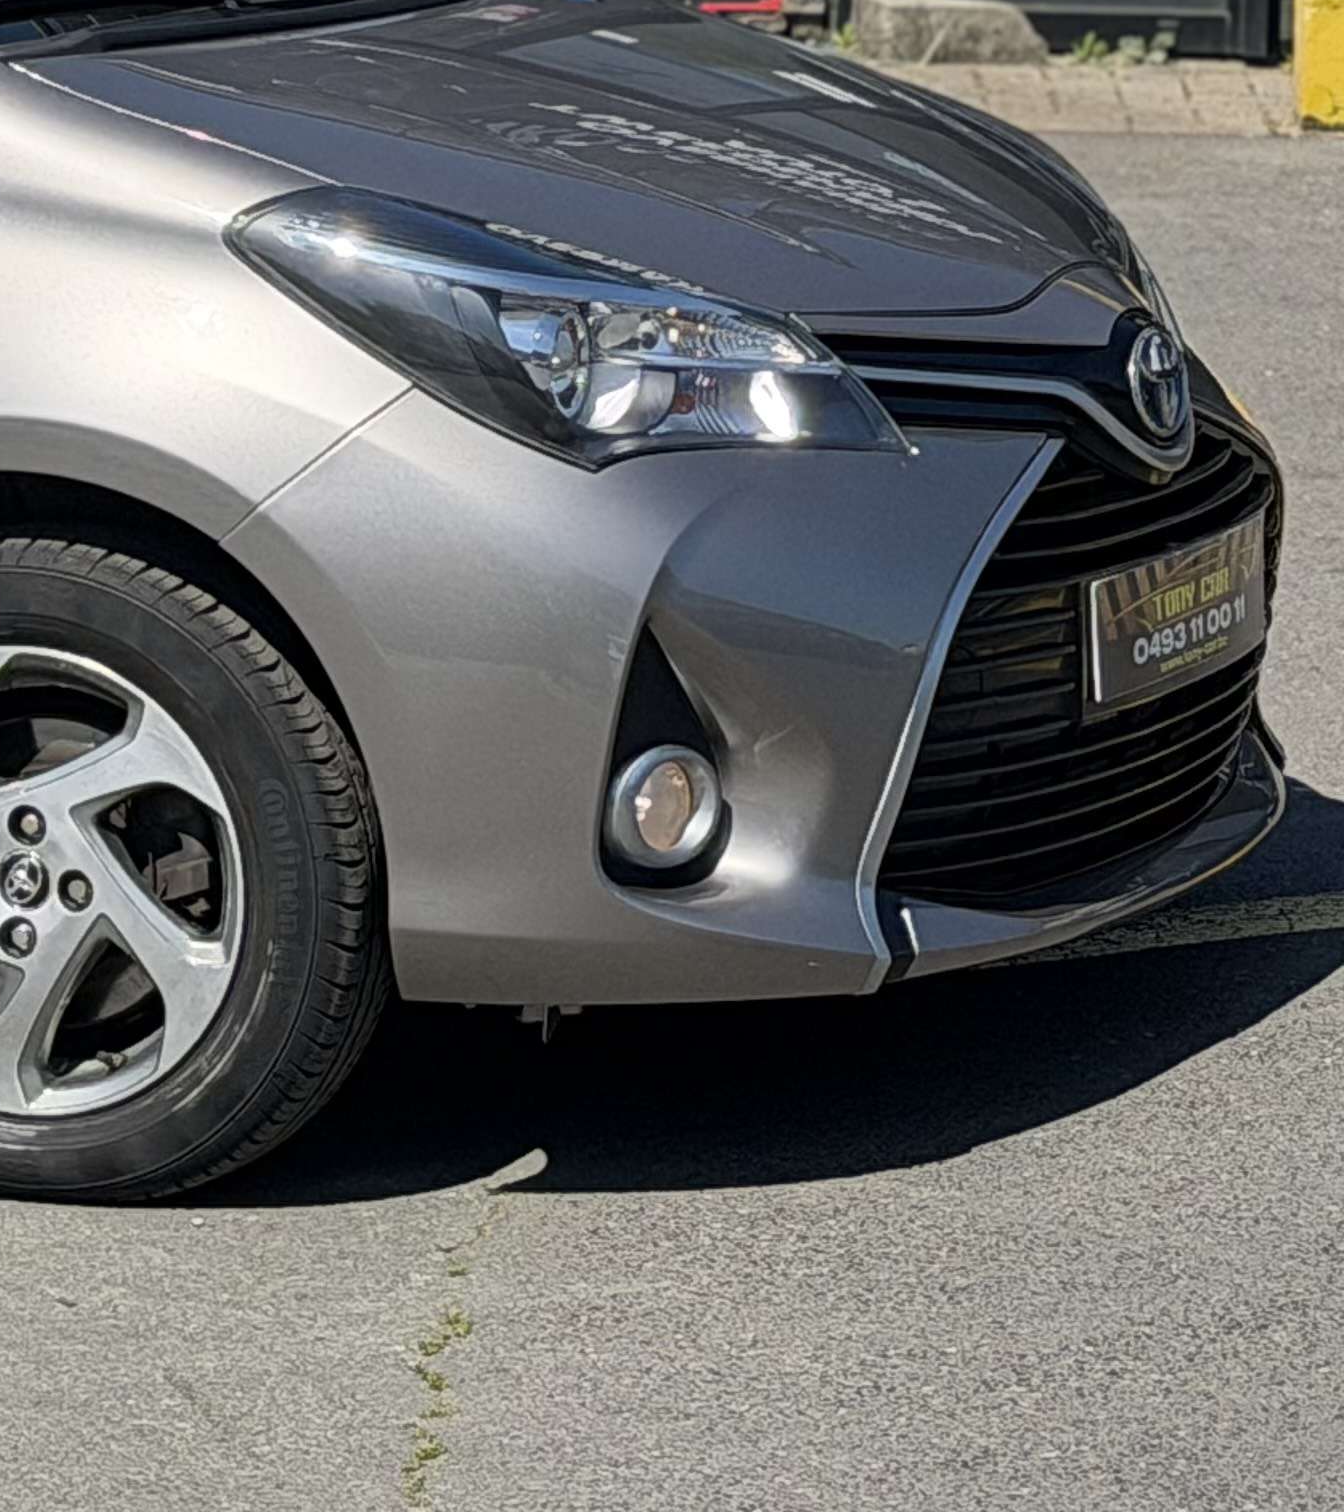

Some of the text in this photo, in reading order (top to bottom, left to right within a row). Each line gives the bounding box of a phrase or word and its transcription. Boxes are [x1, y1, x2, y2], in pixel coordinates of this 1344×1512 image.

[1153, 580, 1196, 622] TONY
[1133, 621, 1188, 665] 0493
[1190, 612, 1204, 643] 11
[1207, 602, 1233, 636] 00
